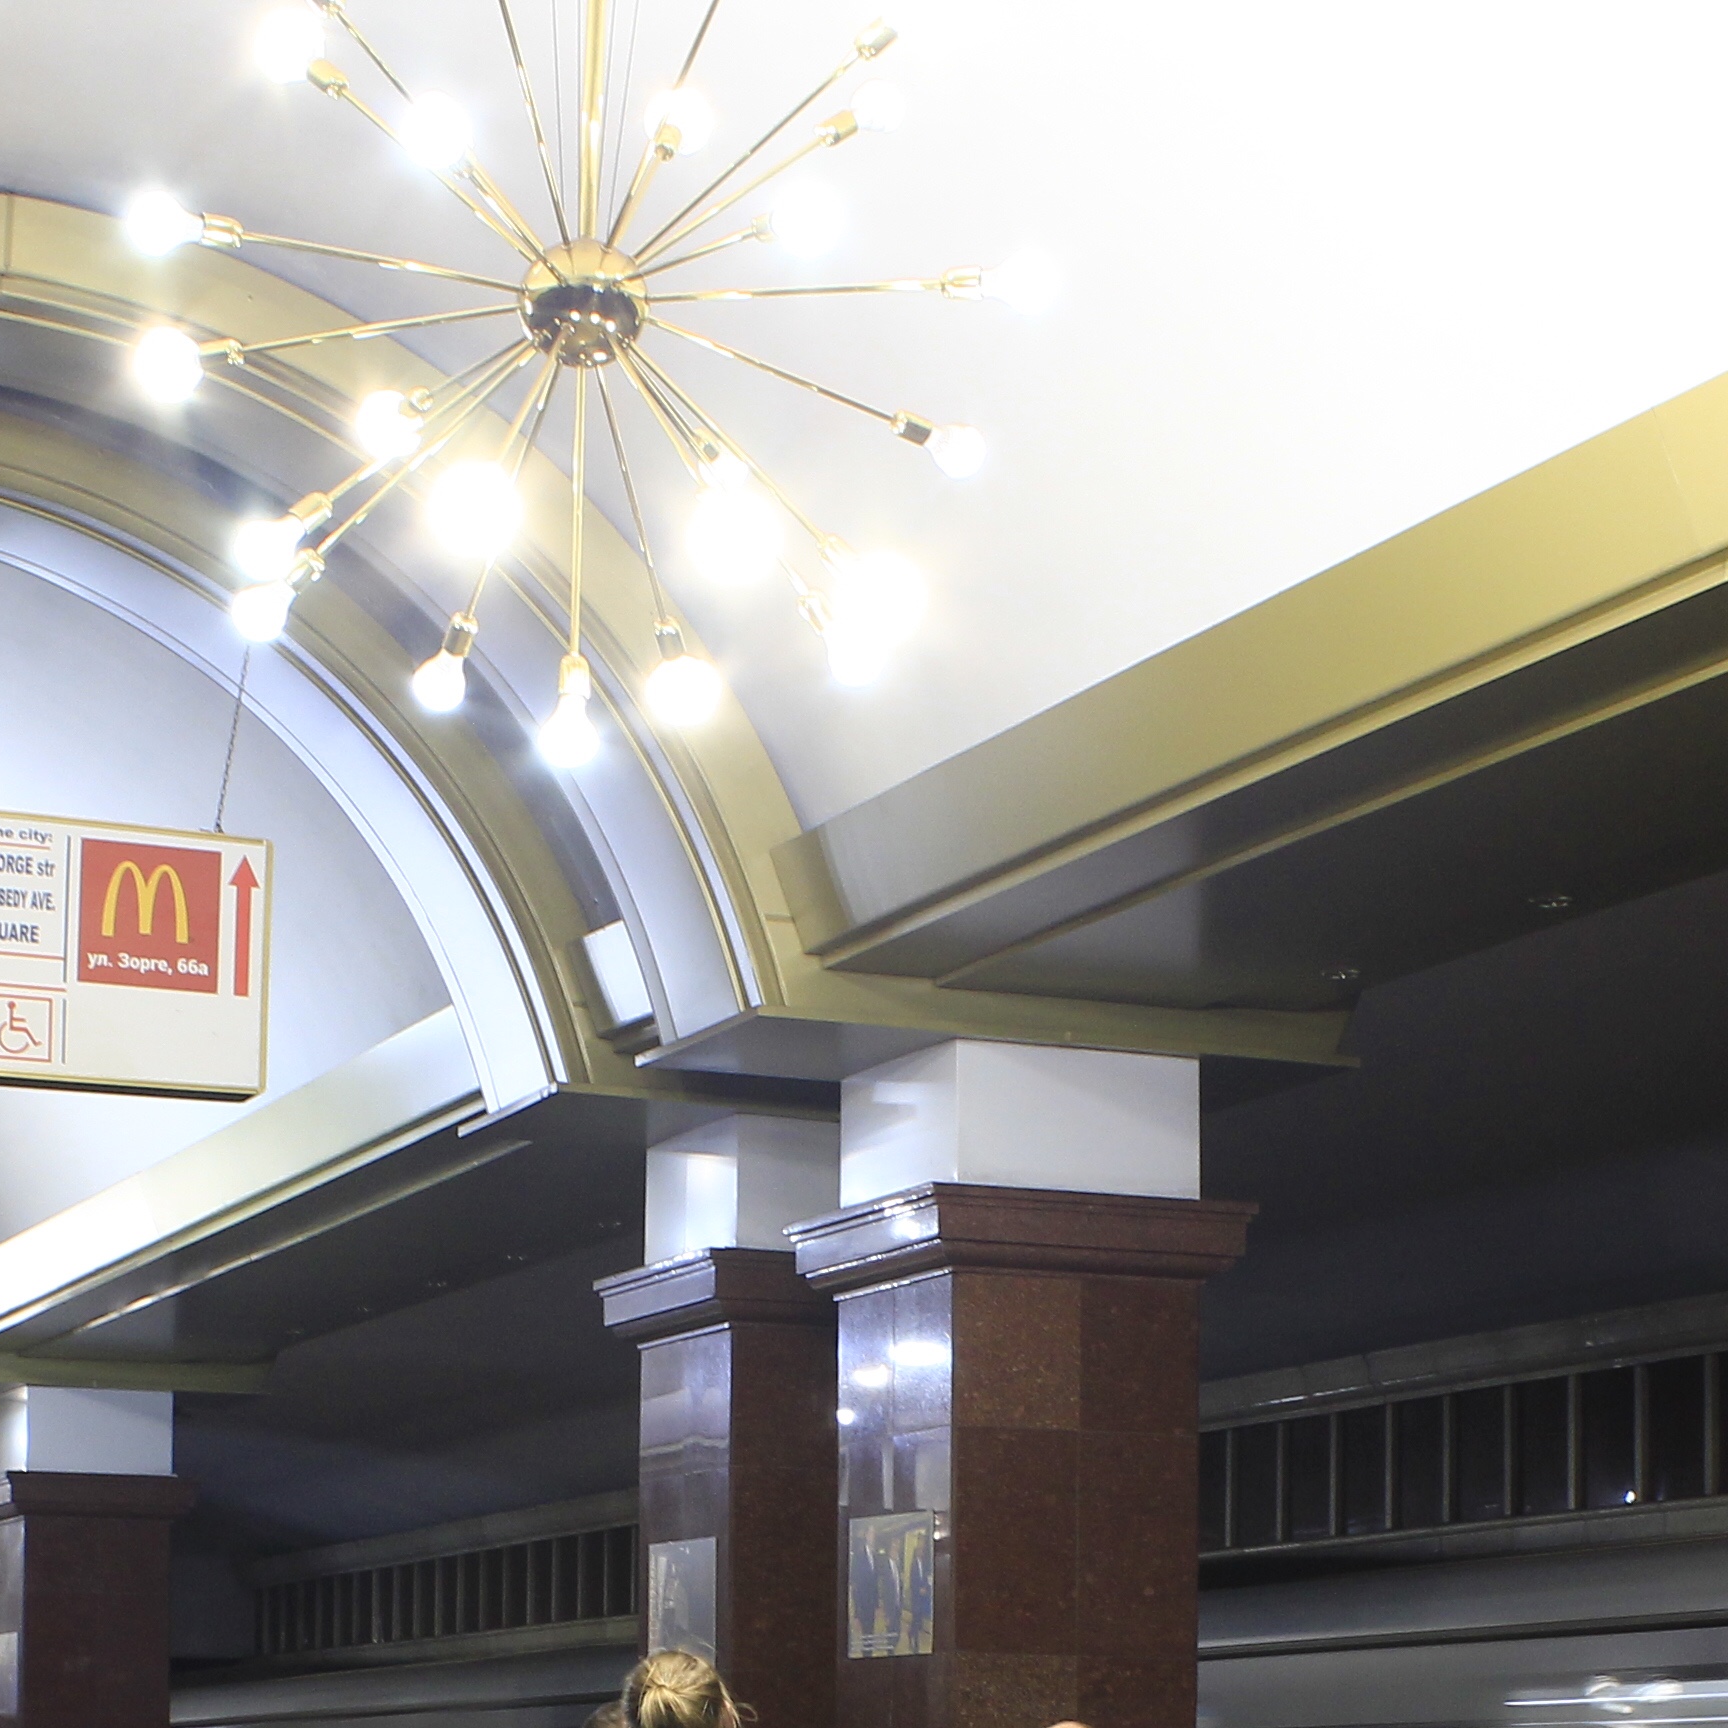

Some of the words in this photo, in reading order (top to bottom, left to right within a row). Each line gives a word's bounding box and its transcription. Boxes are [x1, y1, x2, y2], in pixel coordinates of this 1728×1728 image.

[19, 828, 53, 844] city:
[30, 891, 55, 911] AVE.
[87, 952, 113, 969] ул.
[118, 953, 173, 975] Зорге,
[177, 958, 209, 976] 66а
